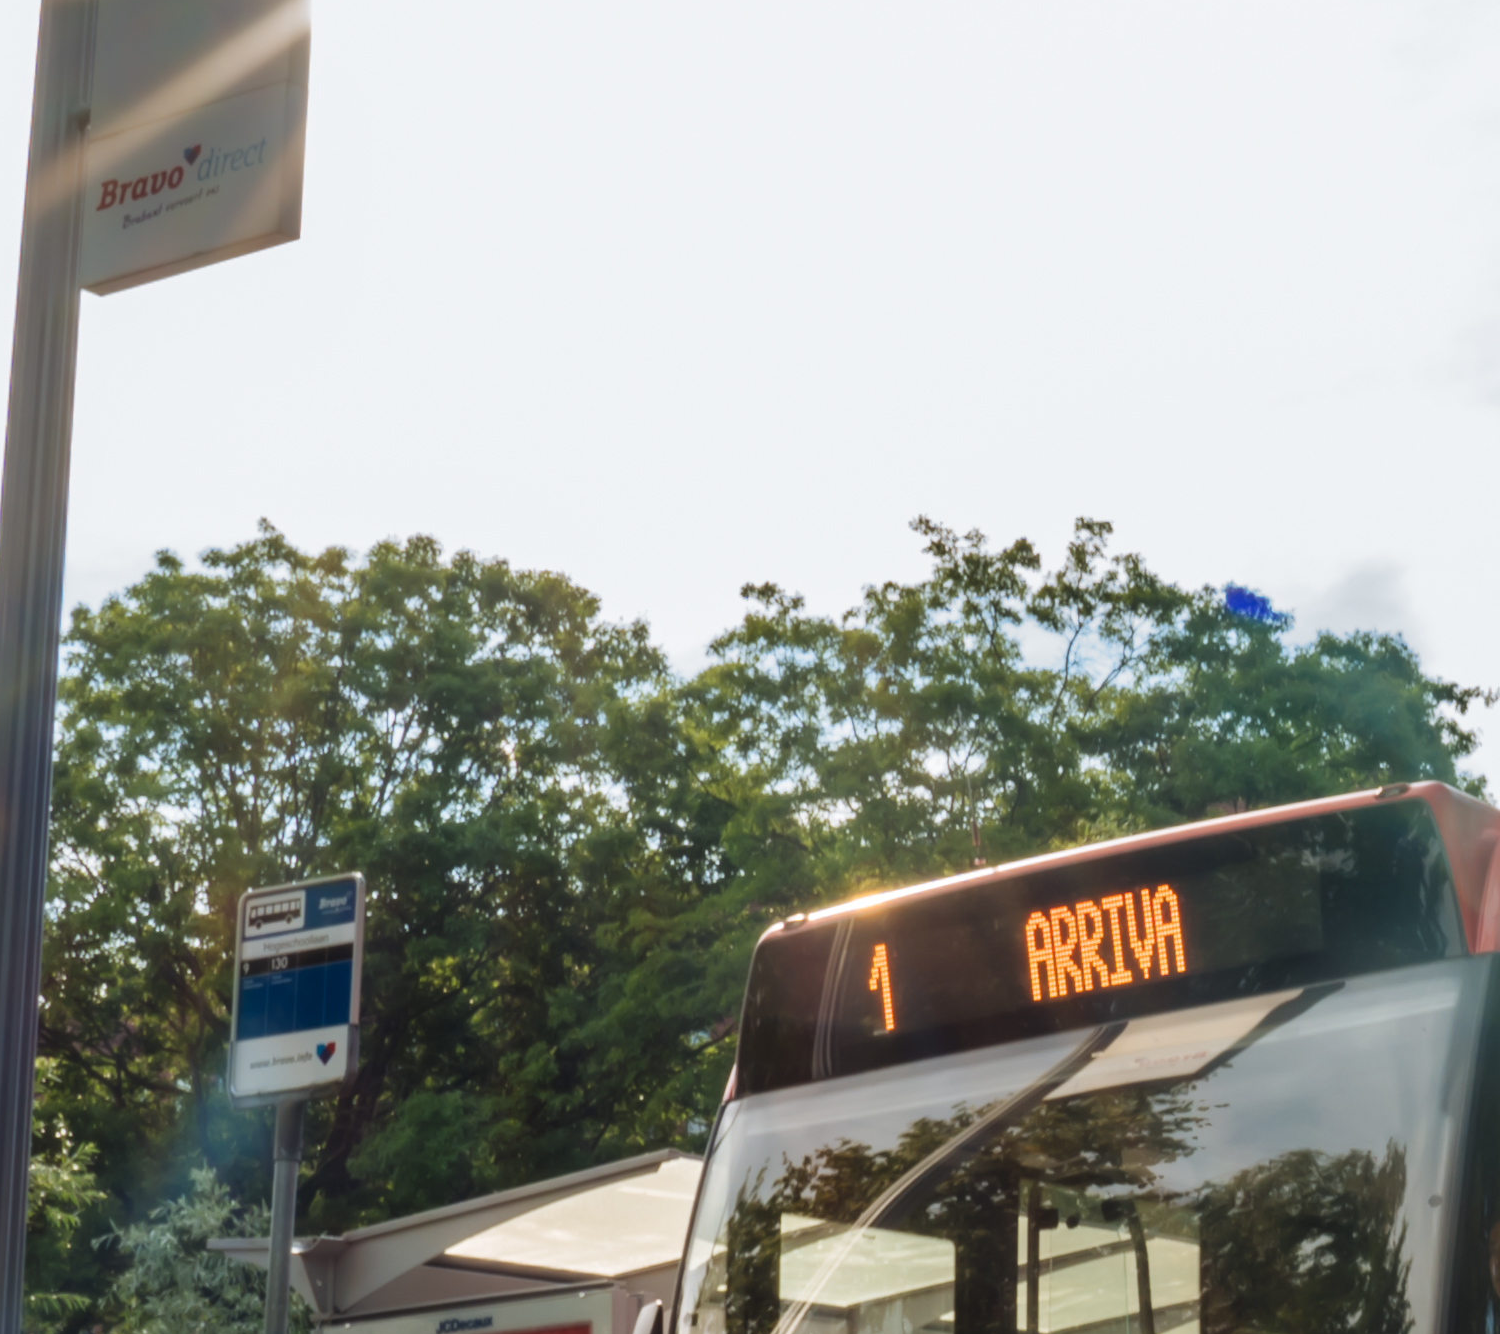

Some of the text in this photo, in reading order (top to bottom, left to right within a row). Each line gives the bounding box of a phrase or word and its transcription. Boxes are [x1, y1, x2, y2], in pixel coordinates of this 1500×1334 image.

[96, 137, 268, 212] Bravo direct
[318, 897, 348, 910] Bravo
[271, 956, 288, 971] 130
[869, 884, 1186, 1031] 1 ARRIVA
[436, 1317, 493, 1334] JCDecaux
